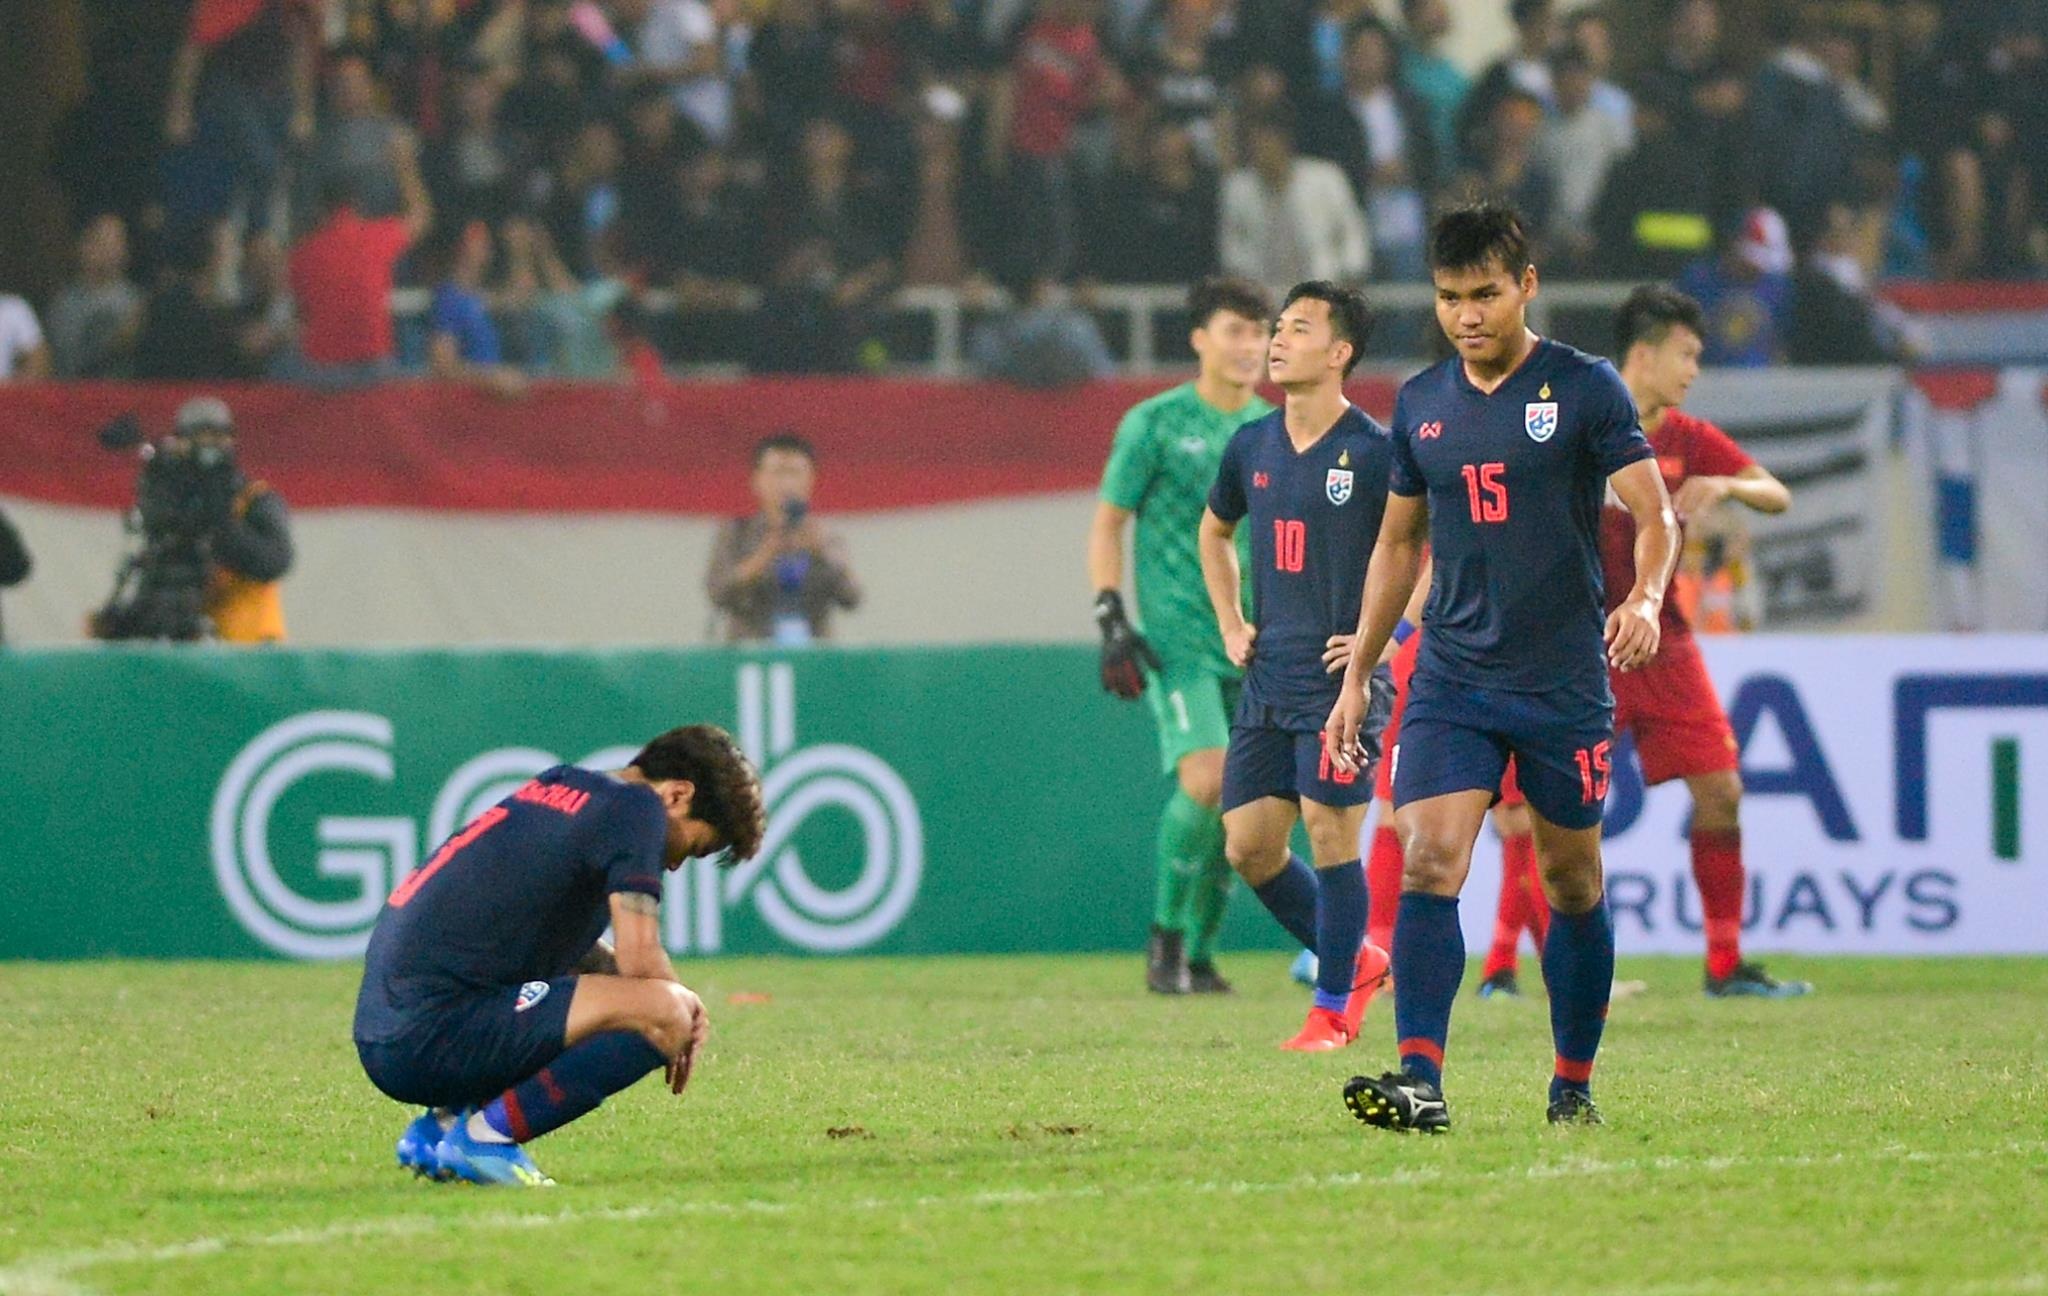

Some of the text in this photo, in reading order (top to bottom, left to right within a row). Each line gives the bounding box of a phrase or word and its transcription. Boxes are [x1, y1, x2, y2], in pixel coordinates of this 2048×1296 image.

[1461, 462, 1508, 523] 15
[1274, 518, 1306, 573] 10
[1574, 739, 1610, 804] 15
